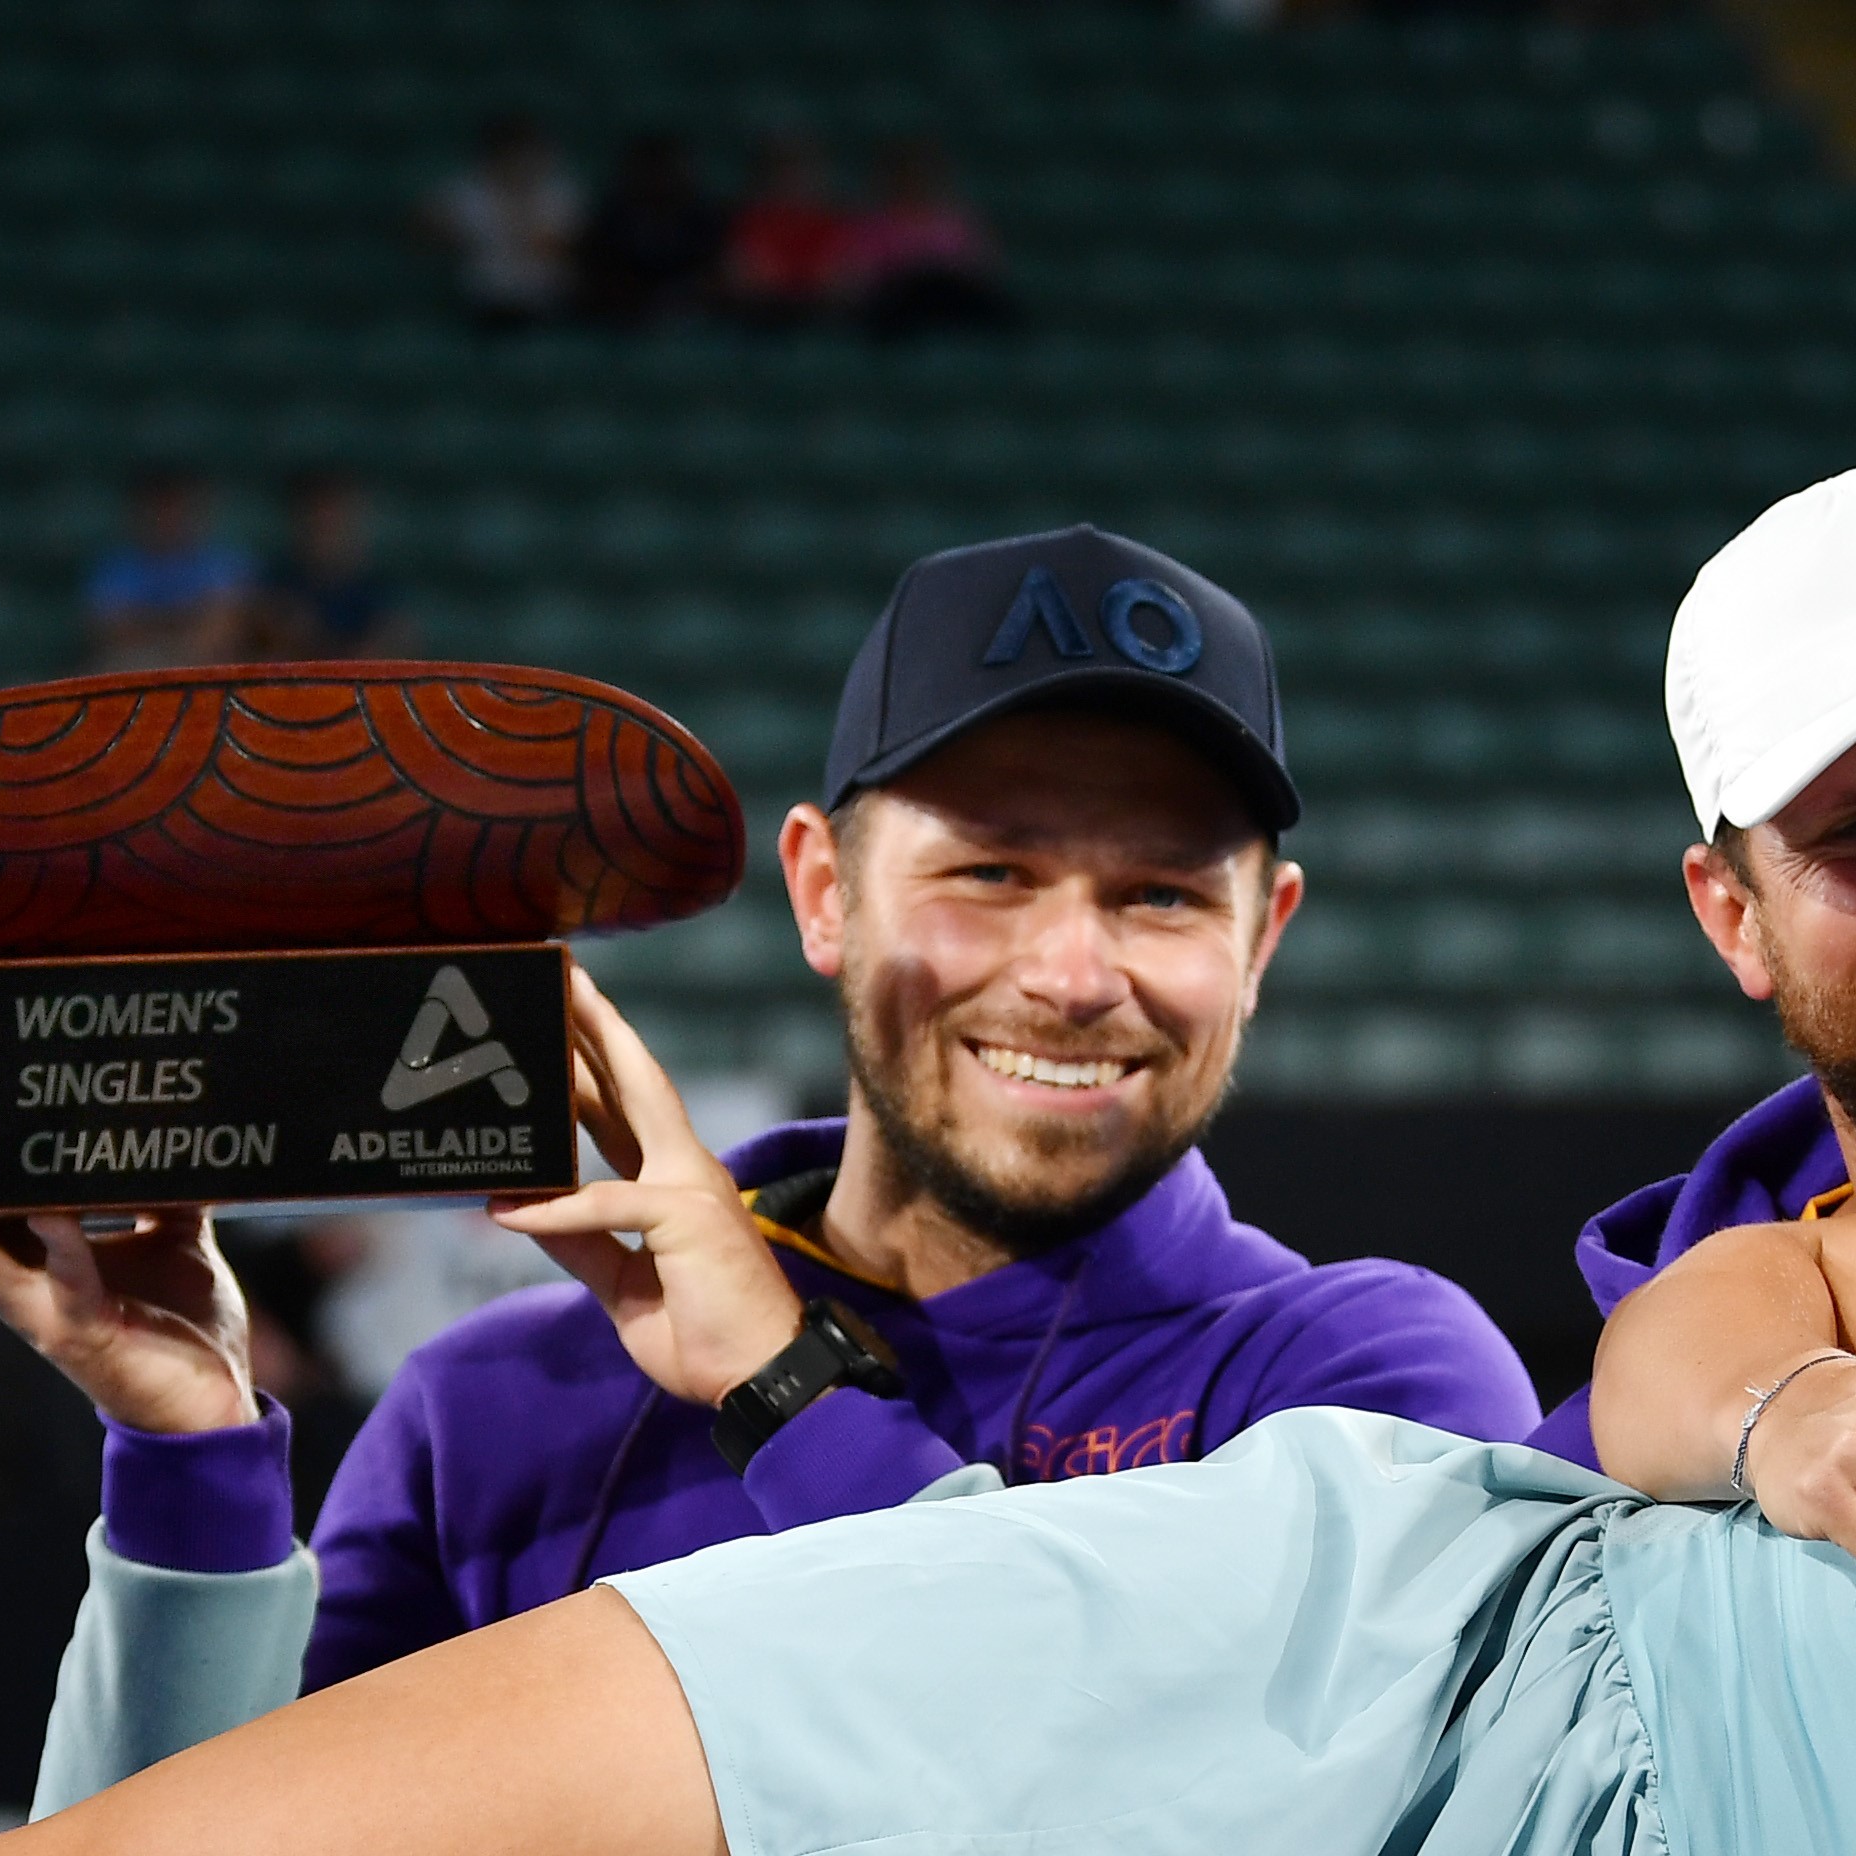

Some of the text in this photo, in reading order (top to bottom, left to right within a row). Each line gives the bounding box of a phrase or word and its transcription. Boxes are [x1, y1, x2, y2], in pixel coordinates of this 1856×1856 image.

[14, 989, 240, 1040] WOMEN'S
[15, 1057, 204, 1108] SINGLES
[19, 1121, 277, 1175] CHAMPION
[329, 1126, 534, 1161] ADELAIDE
[400, 1160, 533, 1176] INTERNATIONAL
